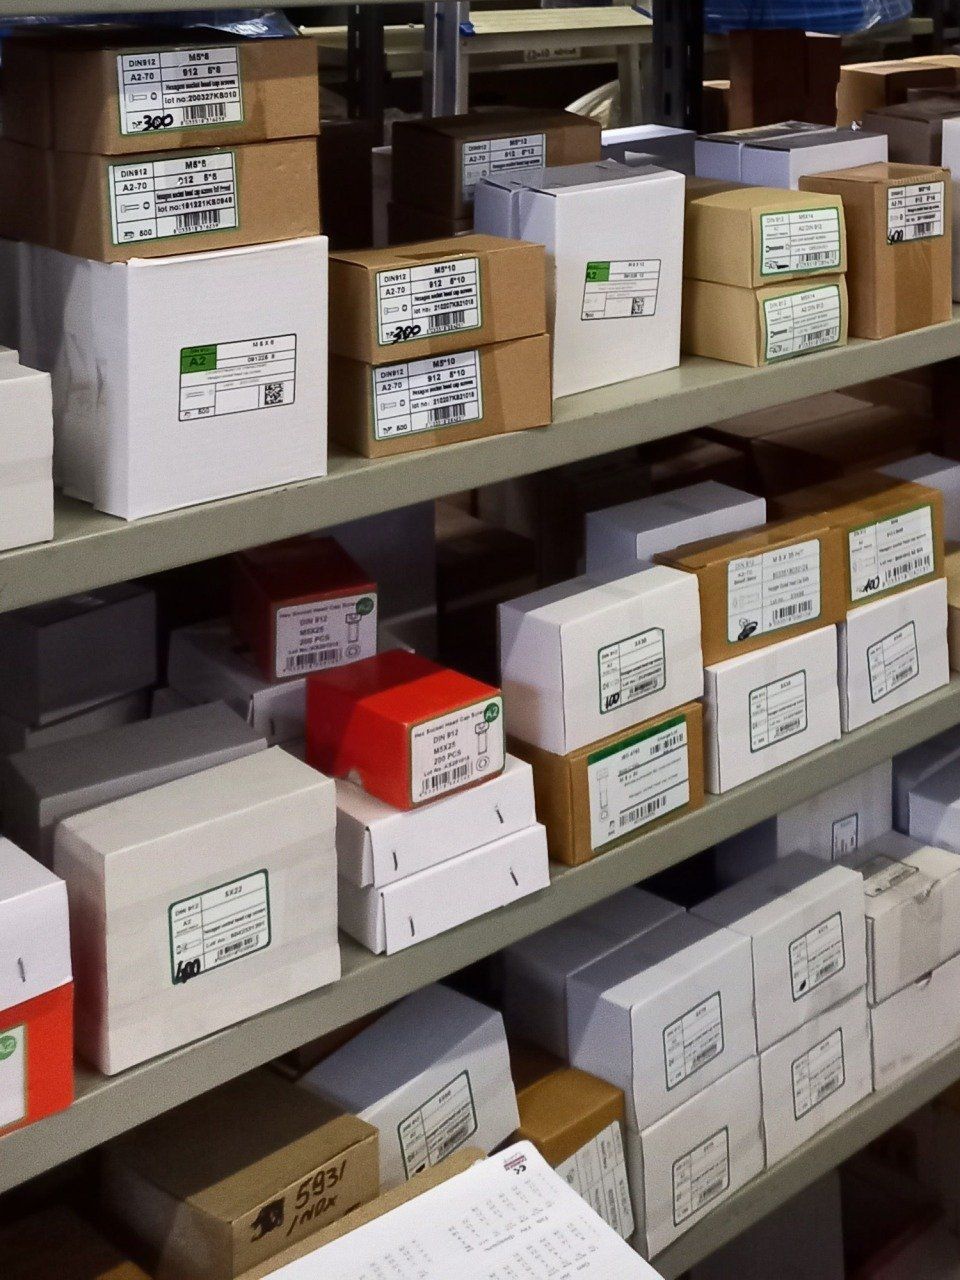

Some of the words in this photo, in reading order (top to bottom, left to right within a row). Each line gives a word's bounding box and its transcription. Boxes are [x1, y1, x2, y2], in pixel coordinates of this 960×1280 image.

[129, 59, 155, 67] DIN912
[183, 68, 198, 76] 912
[131, 73, 154, 82] A2-70
[142, 114, 173, 131] 300
[121, 169, 147, 177] DIN912
[123, 184, 147, 192] A2-70
[384, 274, 406, 282] DIN912
[386, 287, 405, 295] A2-70
[189, 356, 206, 366] A2
[381, 369, 403, 378] DIN912
[428, 374, 440, 382] 912
[382, 382, 402, 391] A2-70
[486, 707, 498, 718] A2
[434, 735, 445, 743] DIN
[447, 729, 458, 738] 912
[434, 741, 455, 754] M5X25
[434, 755, 446, 765] 200
[447, 749, 461, 760] PCS
